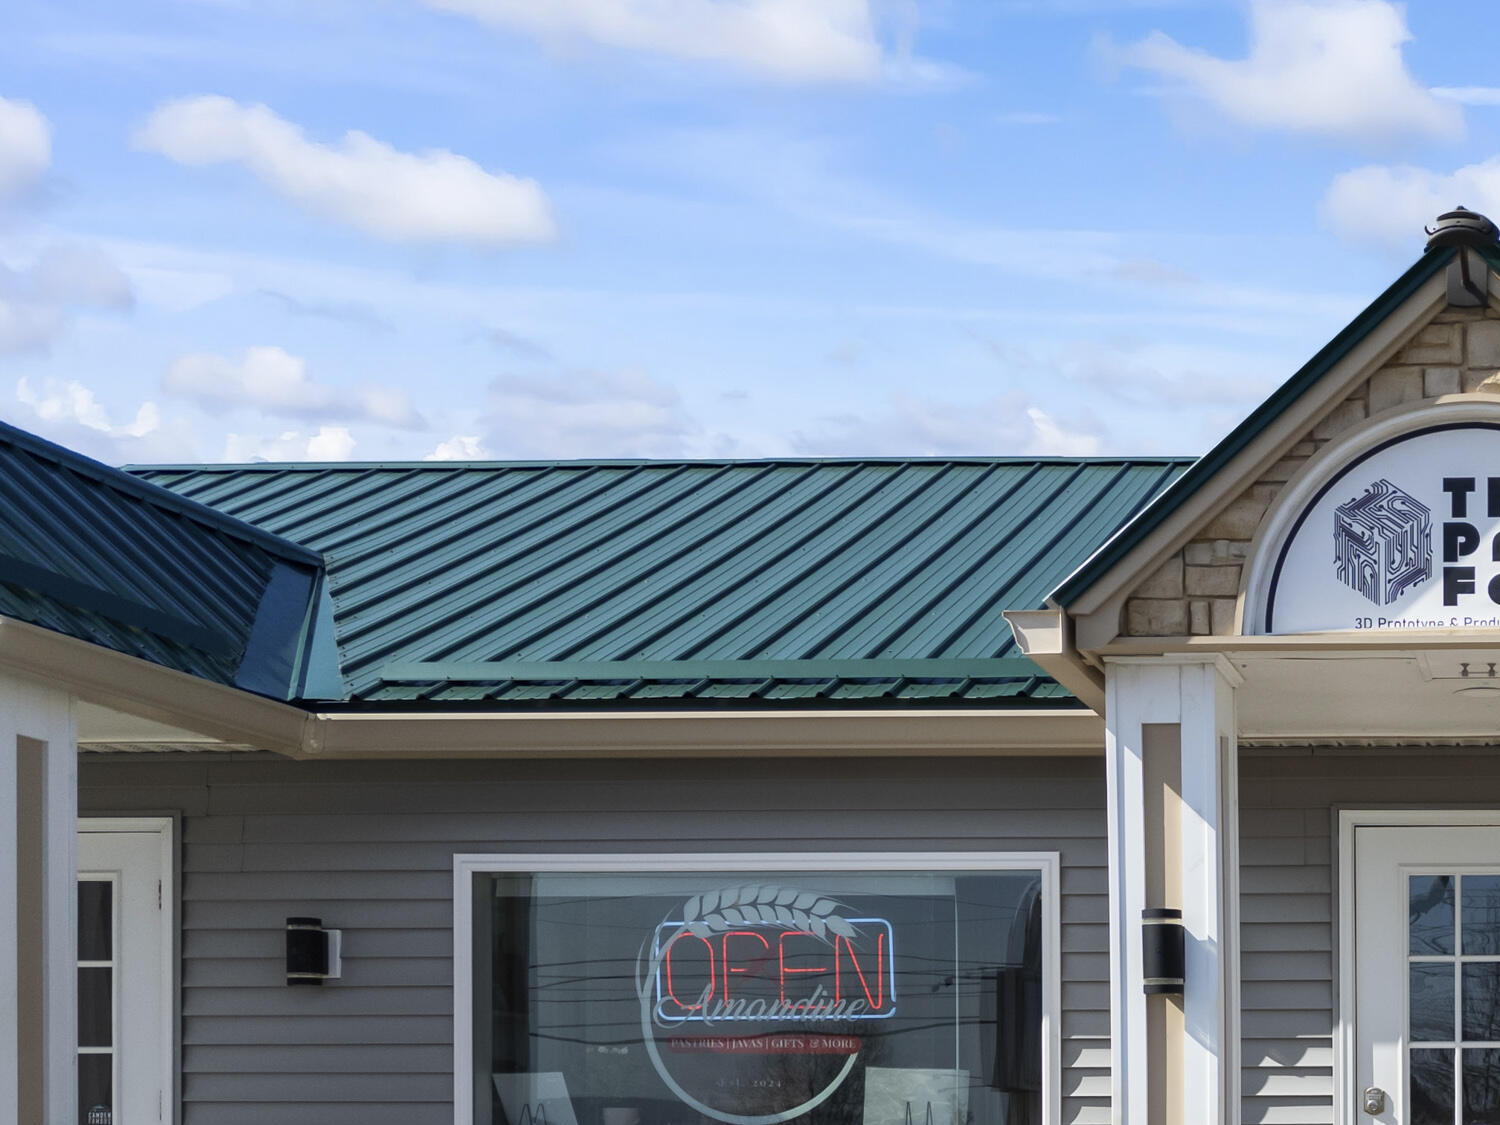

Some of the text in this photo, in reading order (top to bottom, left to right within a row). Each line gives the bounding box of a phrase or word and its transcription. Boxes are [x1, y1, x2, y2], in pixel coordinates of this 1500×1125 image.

[1355, 617, 1373, 629] 3D
[667, 931, 884, 1009] OPEN
[653, 983, 869, 1028] Amandine
[771, 1038, 805, 1048] GIFTS
[822, 1038, 856, 1048] MORE
